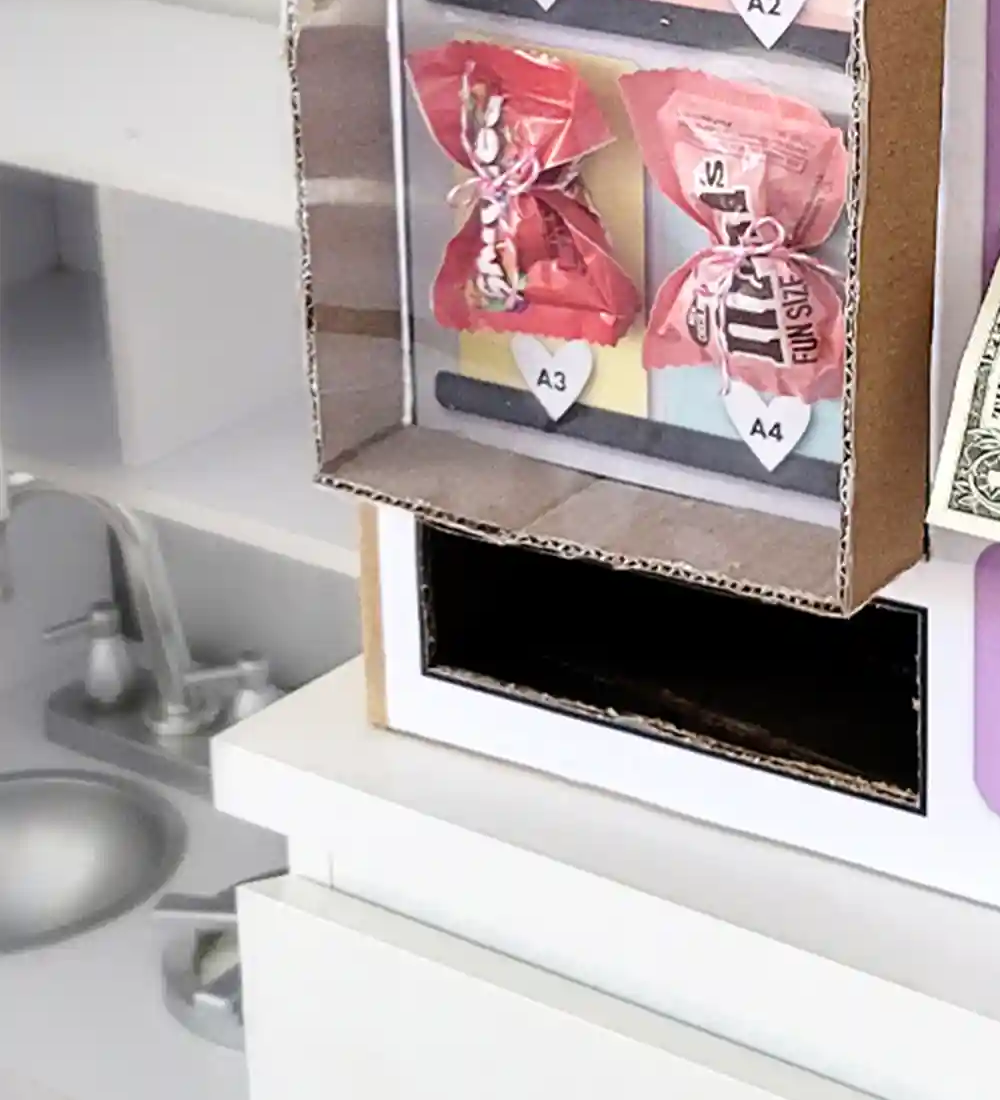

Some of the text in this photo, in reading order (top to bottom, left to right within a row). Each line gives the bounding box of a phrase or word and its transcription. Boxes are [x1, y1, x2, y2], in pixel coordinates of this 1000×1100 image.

[779, 274, 813, 320] SIZE
[785, 321, 819, 365] FUN
[536, 368, 567, 392] A3
[749, 418, 784, 443] A4
